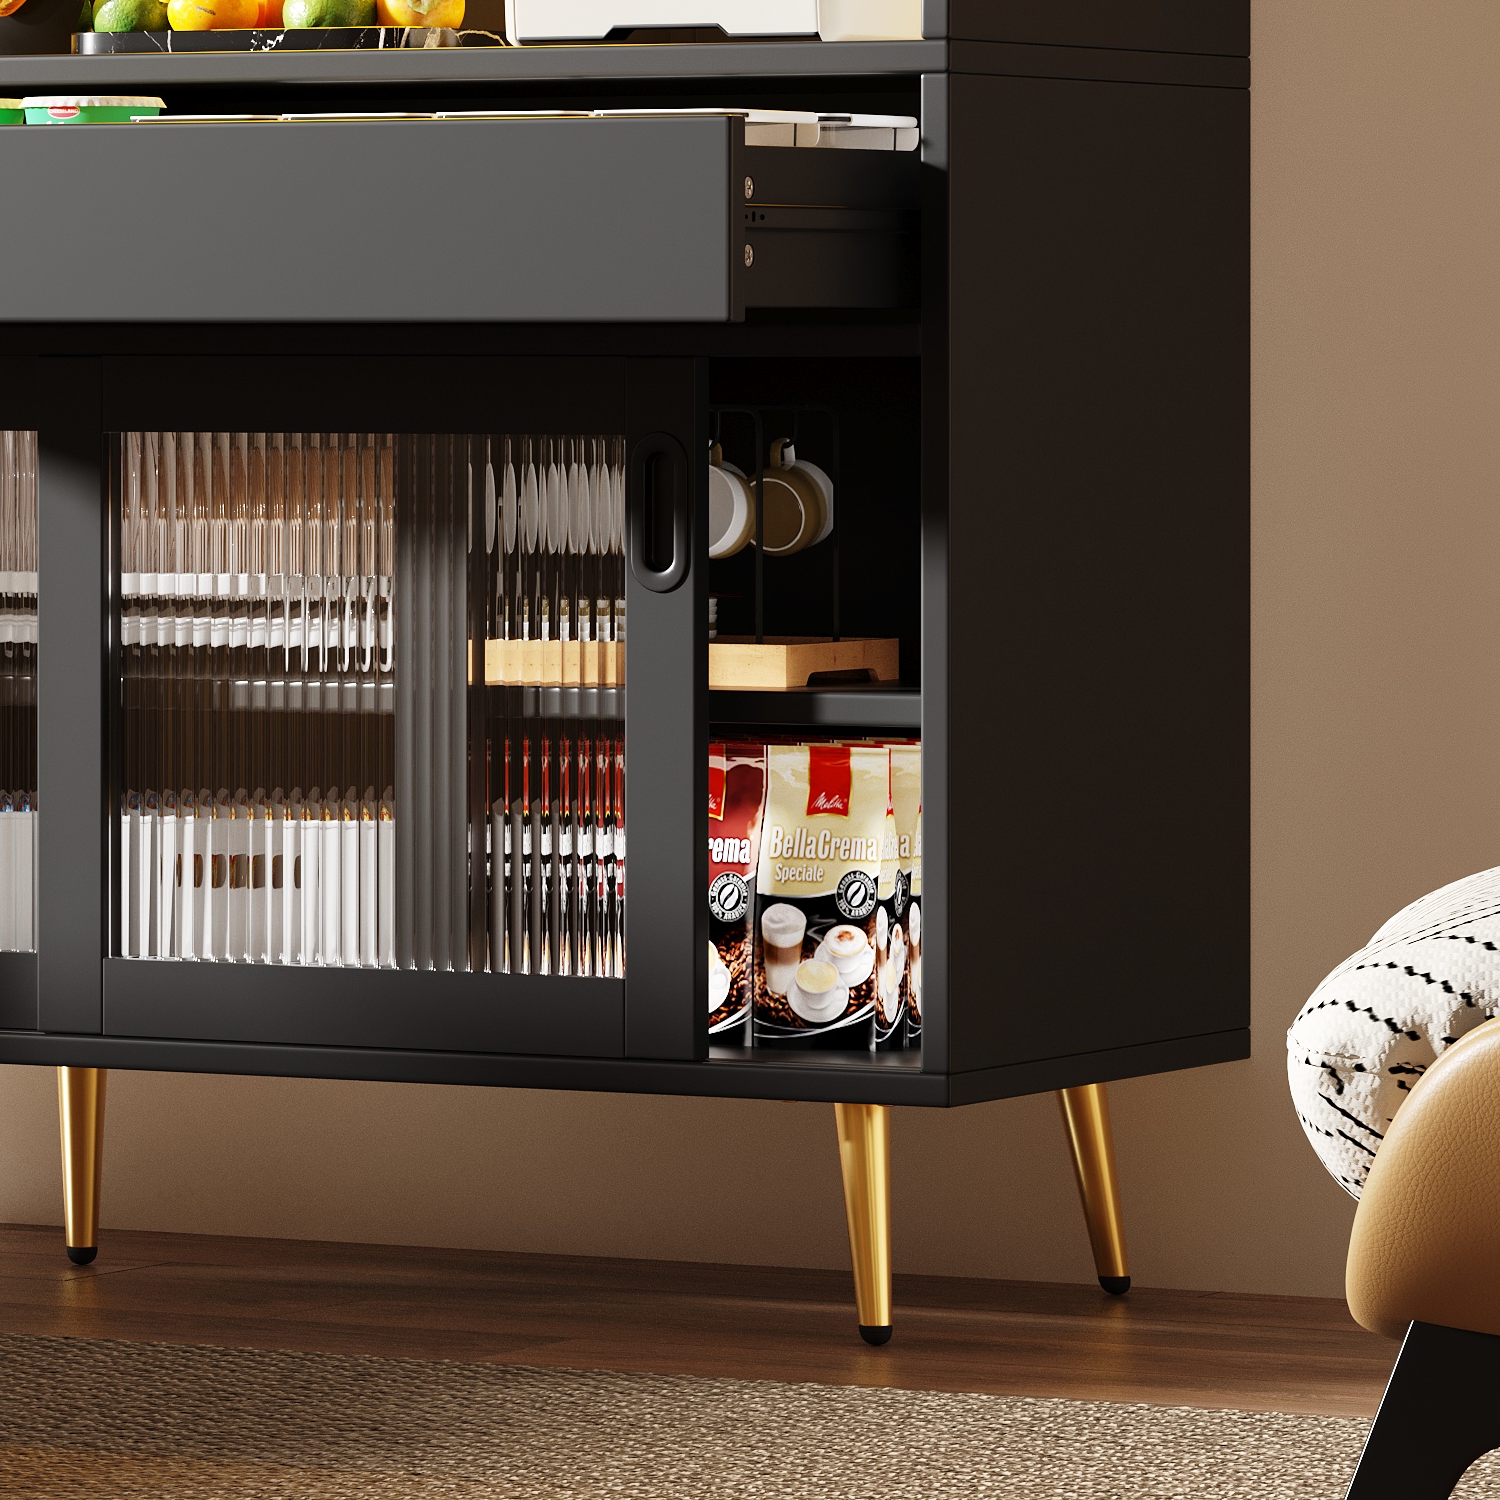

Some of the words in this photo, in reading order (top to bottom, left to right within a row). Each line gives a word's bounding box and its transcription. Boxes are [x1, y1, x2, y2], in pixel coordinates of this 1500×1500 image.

[811, 791, 844, 810] Melitta
[768, 825, 878, 862] BellaCrema
[774, 862, 824, 884] Speciale
